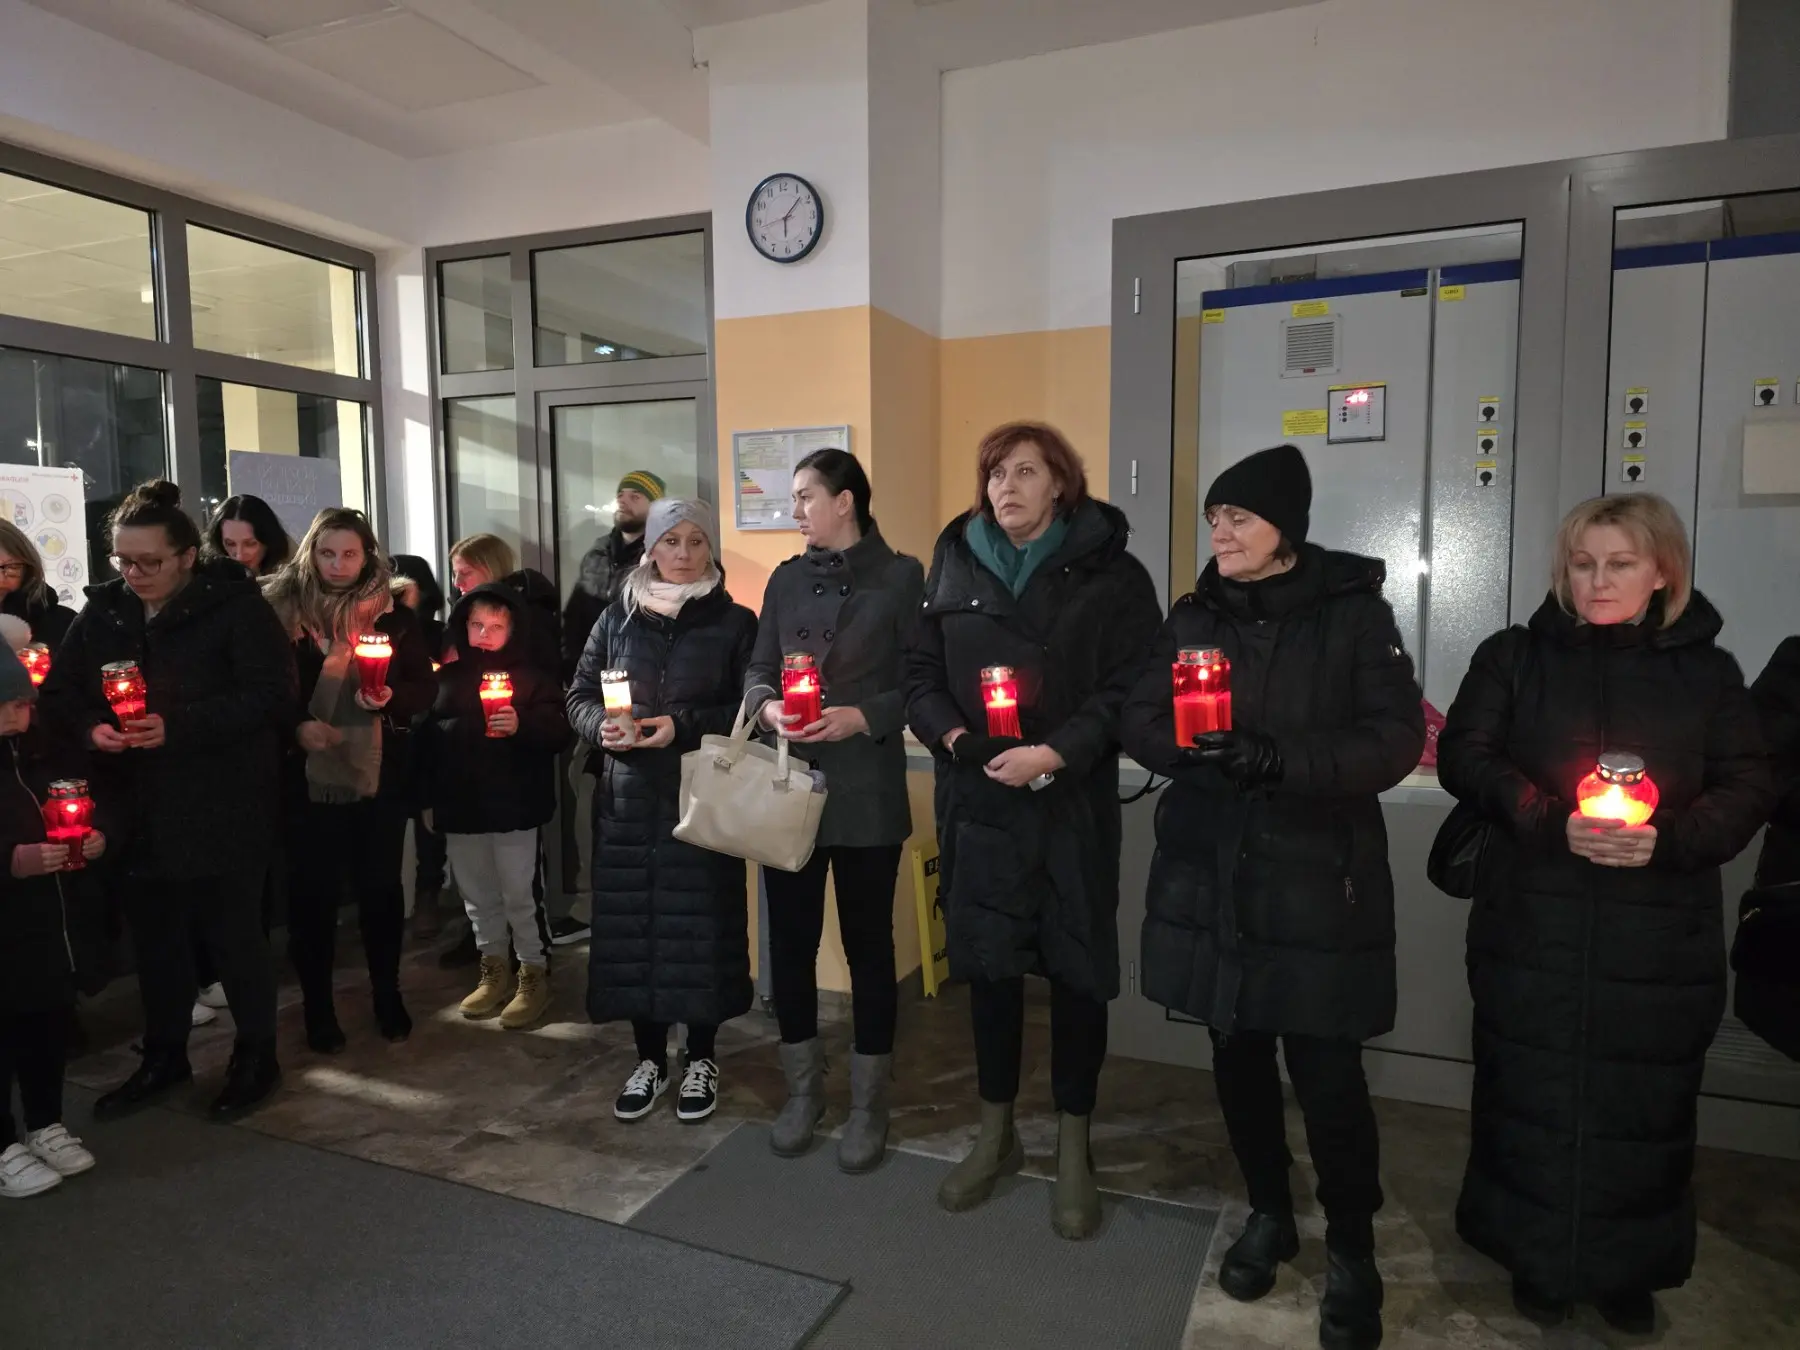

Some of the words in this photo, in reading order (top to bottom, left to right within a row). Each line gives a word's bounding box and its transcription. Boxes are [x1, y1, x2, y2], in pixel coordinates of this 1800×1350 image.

[779, 182, 788, 192] 12
[767, 188, 773, 198] 11
[805, 194, 811, 204] 2
[757, 202, 766, 211] 10
[810, 211, 815, 220] 3
[756, 218, 762, 226] 9
[808, 227, 812, 236] 4
[761, 234, 767, 242] 8
[771, 244, 776, 253] 7
[798, 240, 804, 249] 5
[785, 245, 791, 254] 6
